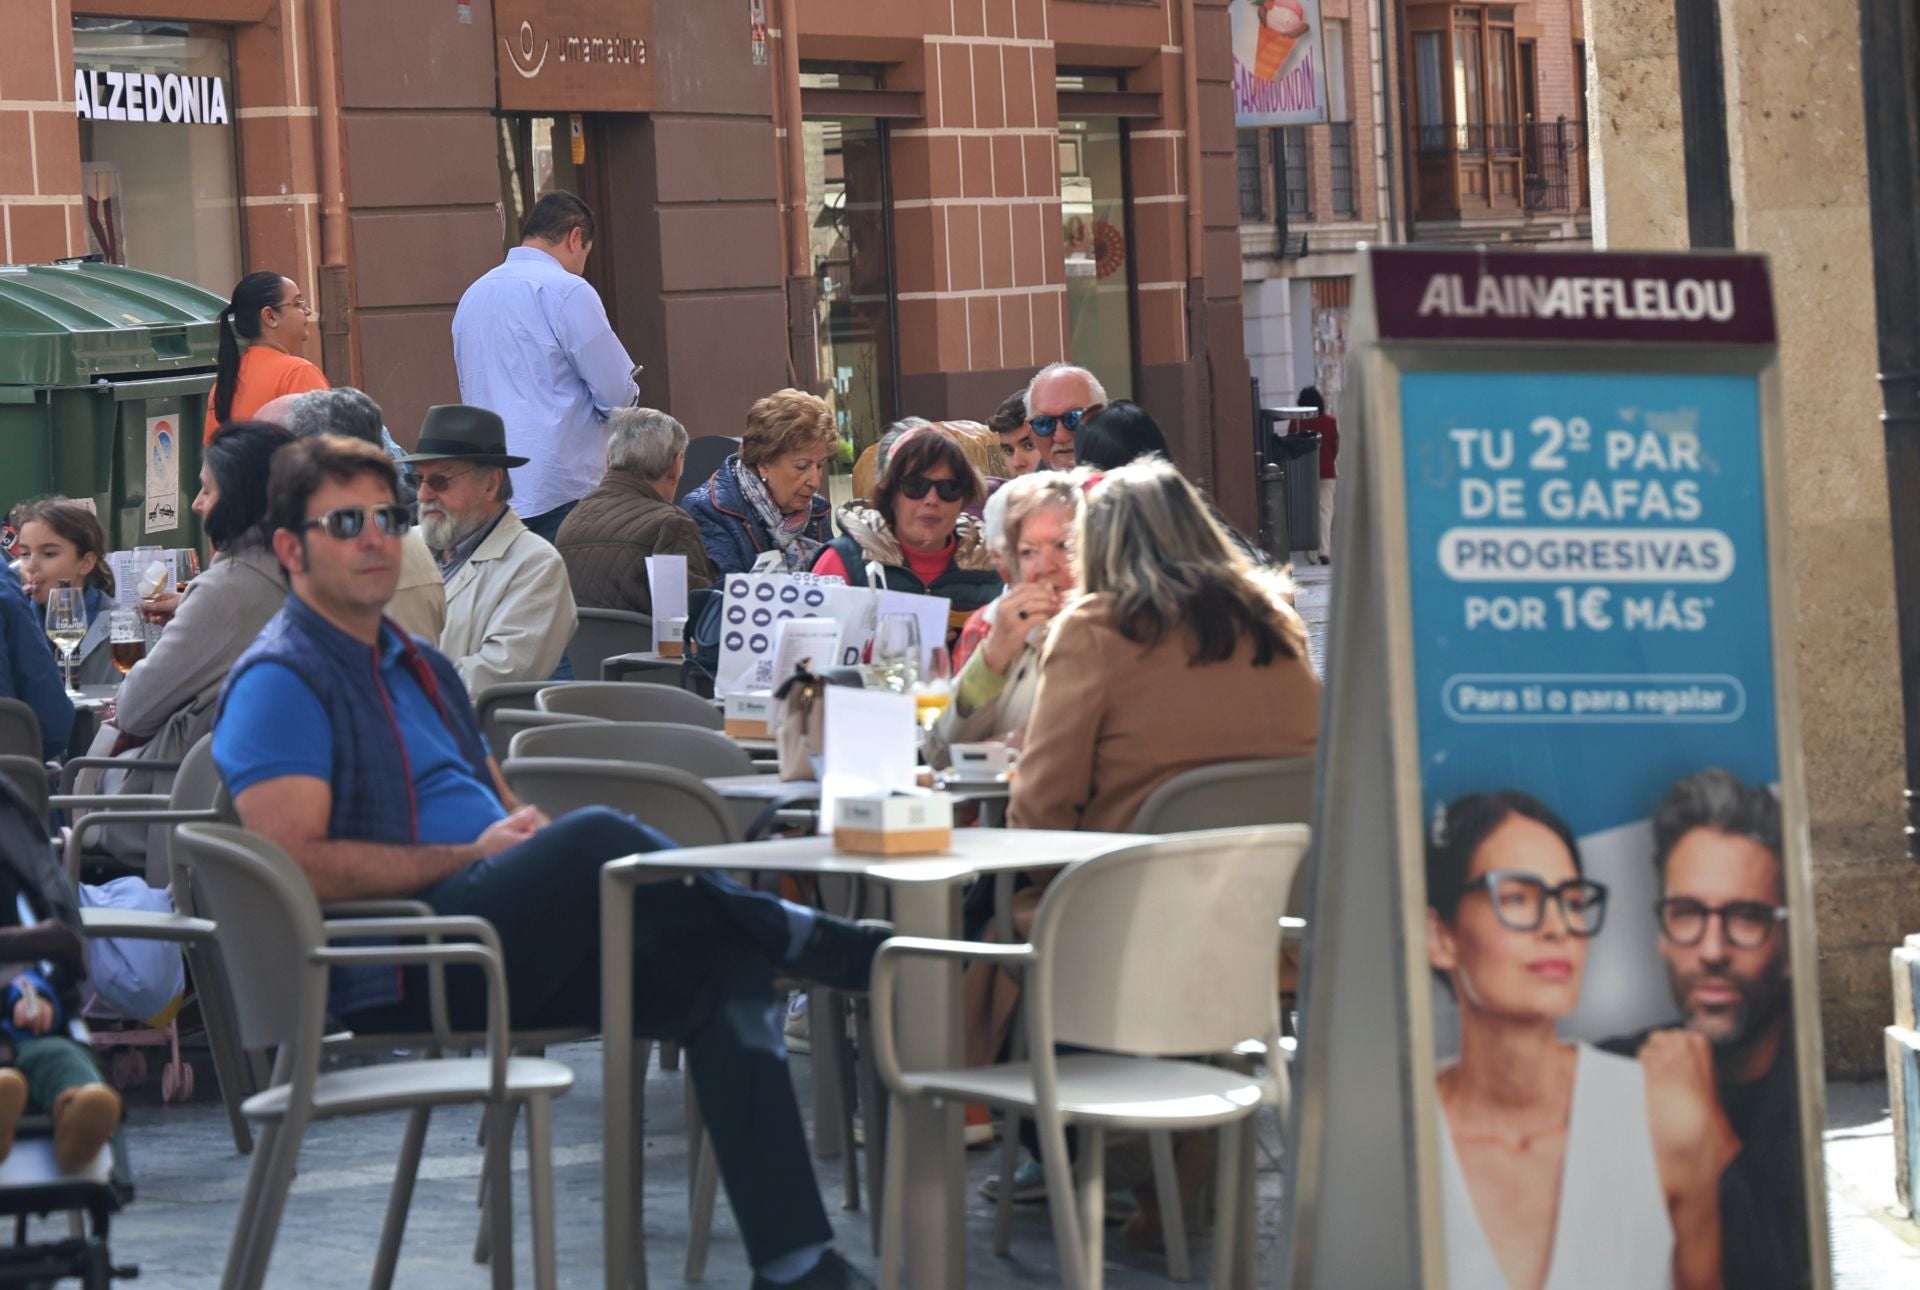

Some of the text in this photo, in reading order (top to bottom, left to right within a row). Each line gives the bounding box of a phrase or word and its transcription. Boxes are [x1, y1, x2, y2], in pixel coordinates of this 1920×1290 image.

[557, 35, 647, 64] umamatura
[75, 69, 229, 125] ALZEDONIA
[1449, 429, 1514, 470] TU
[1605, 430, 1702, 471] PAR
[1459, 478, 1702, 520] DE GAFAS
[1454, 539, 1721, 571] PROGRESIVAS
[1464, 597, 1547, 631] POR
[1555, 586, 1613, 631] 1€
[1458, 685, 1725, 715] Para ti o para regalar
